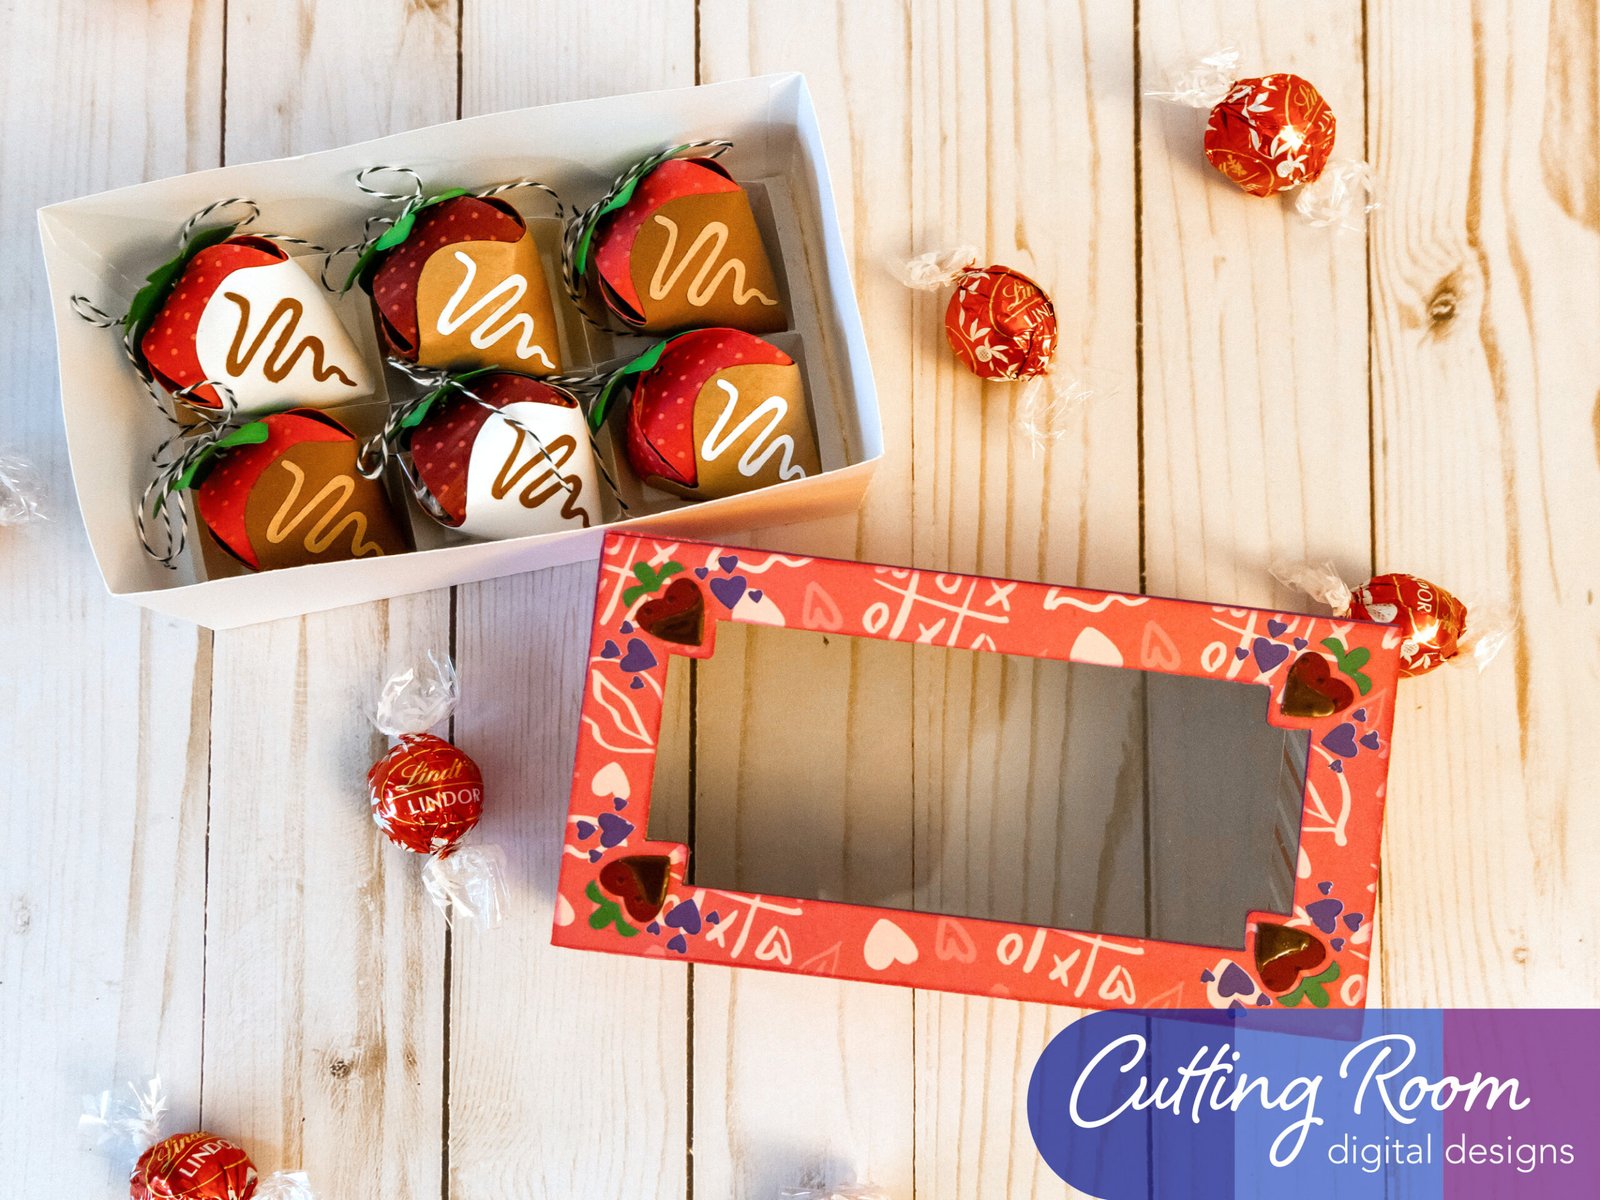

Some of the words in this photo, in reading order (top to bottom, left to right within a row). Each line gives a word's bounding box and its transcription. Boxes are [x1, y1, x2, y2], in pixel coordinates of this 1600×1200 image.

[1002, 280, 1036, 312] Lin
[1023, 302, 1054, 328] LIND
[395, 758, 463, 791] Lindt
[408, 788, 481, 815] LINDOR
